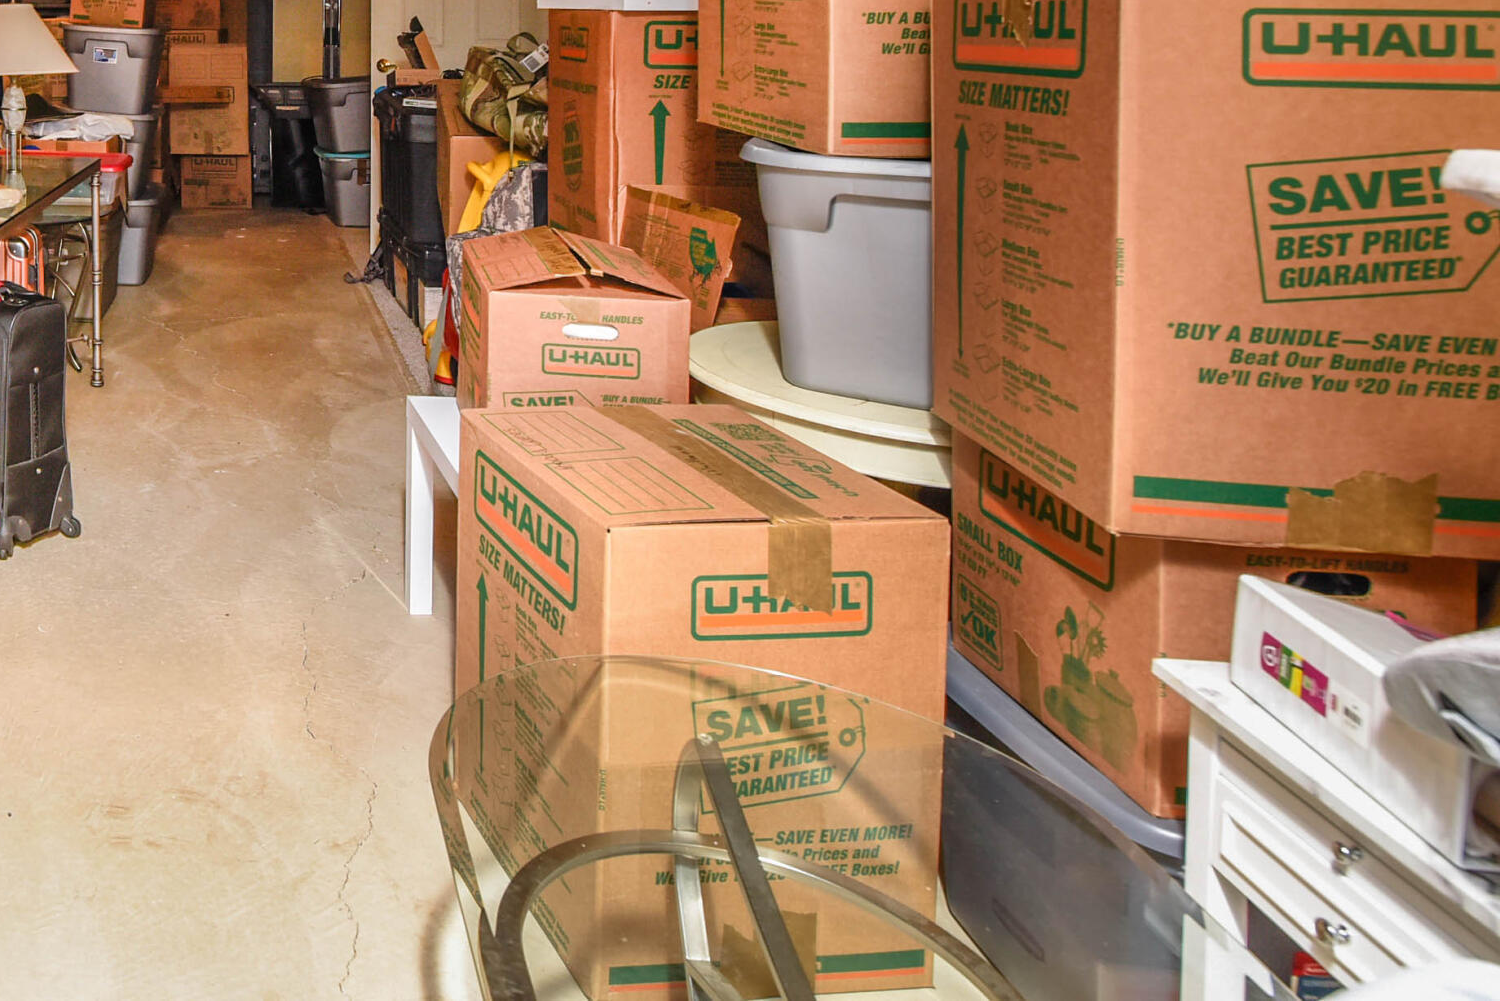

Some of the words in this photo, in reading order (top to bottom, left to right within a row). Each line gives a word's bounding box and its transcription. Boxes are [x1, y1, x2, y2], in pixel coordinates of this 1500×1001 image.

[898, 12, 909, 24] A
[1262, 22, 1495, 58] U-HAUL
[653, 74, 692, 89] SIZE
[959, 80, 985, 105] SIZE
[990, 82, 1071, 117] MATTERS!
[1268, 166, 1445, 216] SAVE!
[1276, 232, 1353, 260] BEST
[1362, 225, 1450, 255] PRICE
[602, 315, 644, 324] HANDLES
[1226, 325, 1241, 342] A
[1438, 336, 1498, 356] EVEN
[549, 349, 634, 367] U-HAUL
[1229, 348, 1279, 367] Beat
[1286, 351, 1324, 369] Our
[1330, 353, 1406, 374] Bundle
[1412, 358, 1481, 378] Prices
[1198, 368, 1250, 387] We'll
[1256, 371, 1303, 390] Give
[1311, 374, 1349, 392] You
[1355, 377, 1390, 395] $20
[1396, 379, 1418, 396] in
[1424, 381, 1480, 399] FREE
[480, 465, 571, 574] U-HAUL
[987, 461, 1104, 557] U-HAUL
[958, 513, 994, 553] SMALL
[998, 541, 1024, 574] BOX
[1246, 554, 1340, 570] EASY-TO-LIFT
[1345, 560, 1409, 574] HANDLES
[478, 534, 500, 571] SIZE
[503, 560, 566, 636] MATTERS!
[973, 617, 997, 650] OK
[706, 694, 827, 743] SAVE!
[724, 752, 763, 777] EST
[769, 742, 829, 770] PRICE
[816, 827, 859, 843] EVEN
[863, 824, 913, 841] MORE!
[852, 844, 880, 859] and
[852, 860, 900, 877] Boxes!
